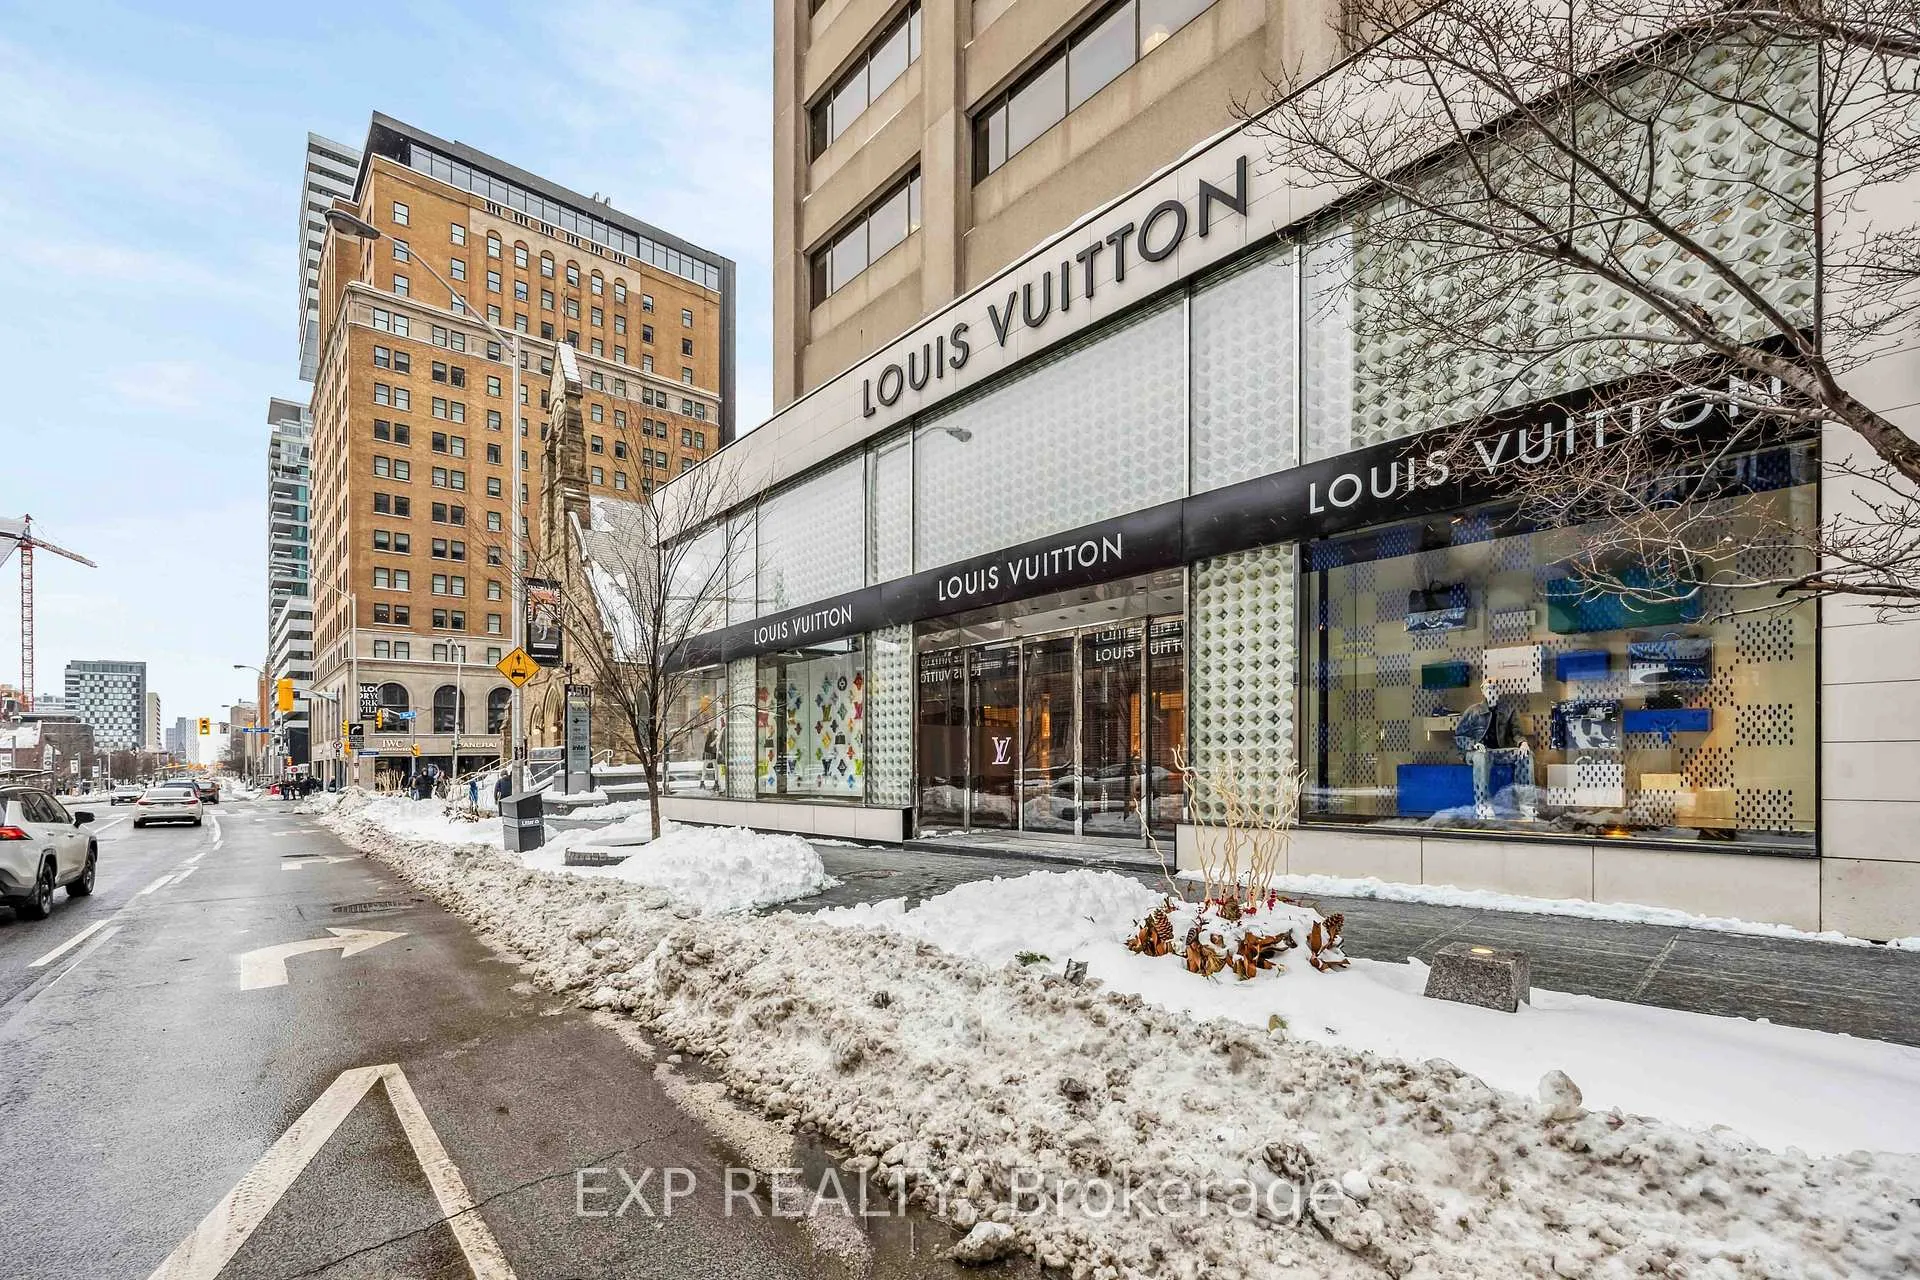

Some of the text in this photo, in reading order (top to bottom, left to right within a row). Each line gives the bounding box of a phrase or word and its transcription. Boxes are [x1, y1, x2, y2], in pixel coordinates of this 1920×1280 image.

[863, 154, 1247, 418] LOUIS VUITTON
[1309, 374, 1782, 515] LOUIS VUITTON
[938, 533, 1123, 602] LOUIS VUITTON
[754, 604, 852, 645] LOUIS VUITTON
[1096, 645, 1135, 662] LOUIS
[382, 739, 404, 748] IWC
[992, 736, 1011, 765] LV
